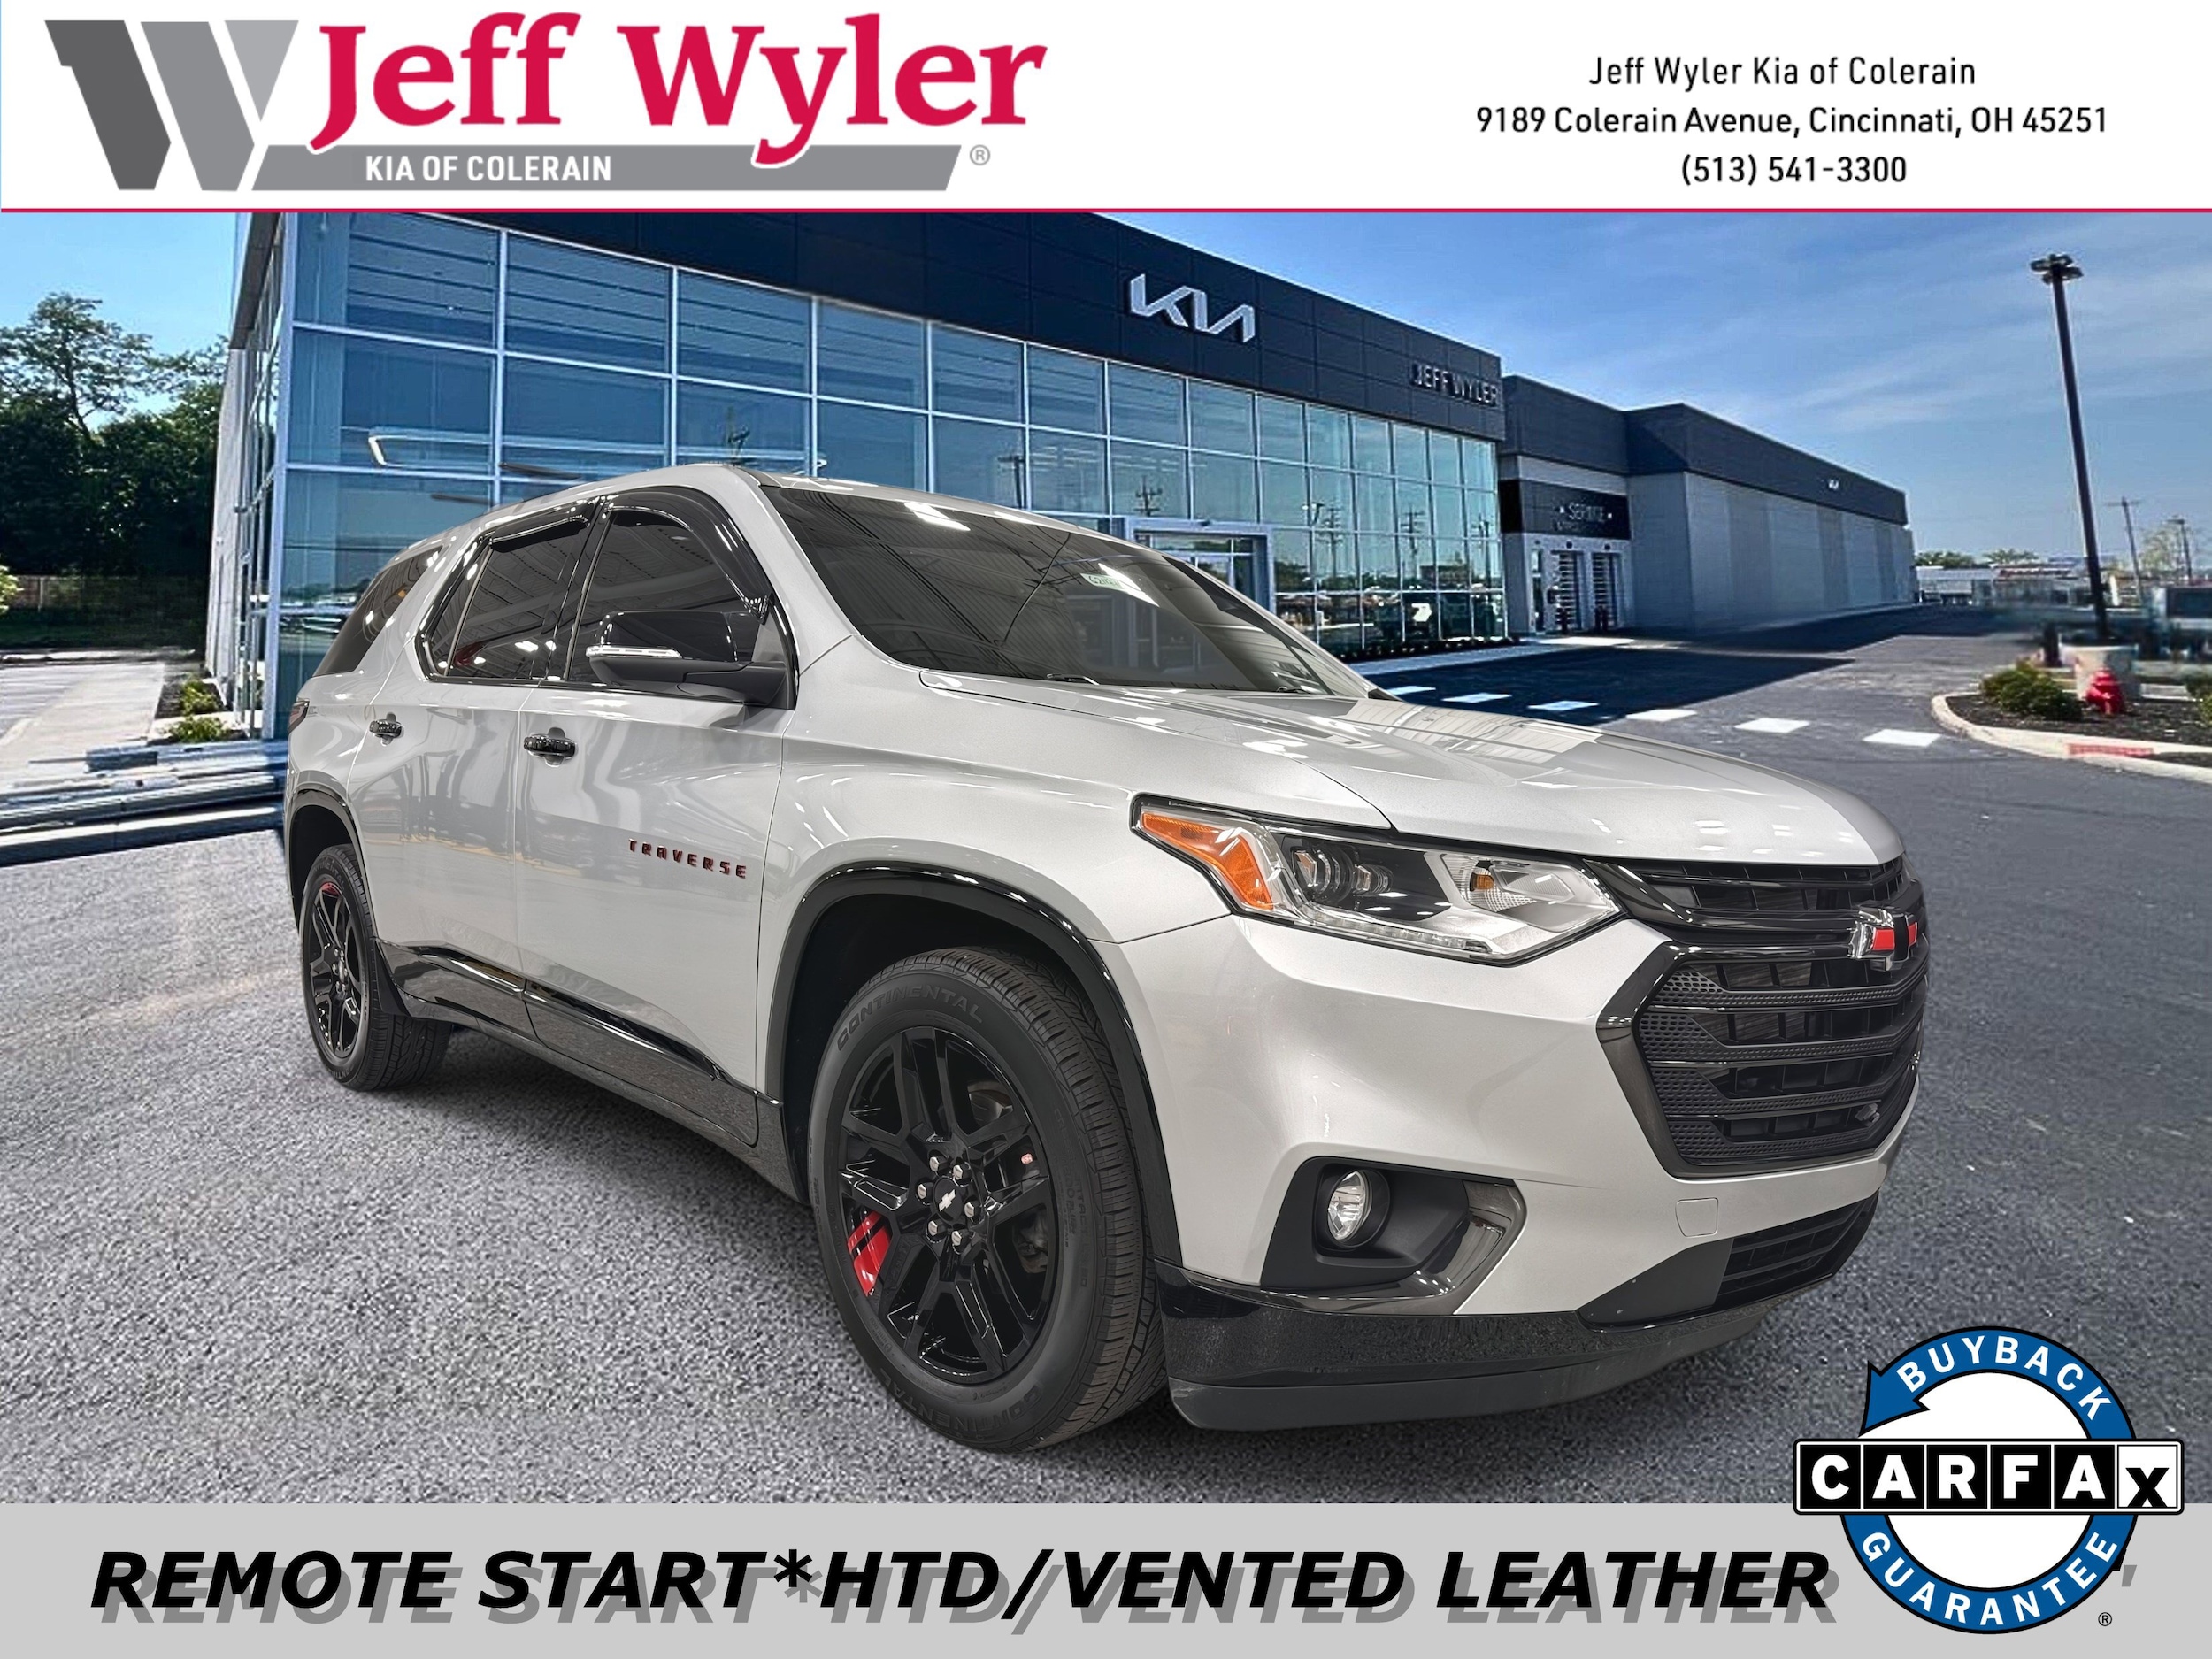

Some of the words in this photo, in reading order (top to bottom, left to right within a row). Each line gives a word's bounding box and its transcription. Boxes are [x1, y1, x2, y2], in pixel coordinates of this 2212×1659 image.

[1130, 273, 1256, 343] KIA
[1413, 363, 1448, 392] JEFF
[628, 838, 748, 879] TRAVERSE
[836, 984, 984, 1051] CONTINENTAL
